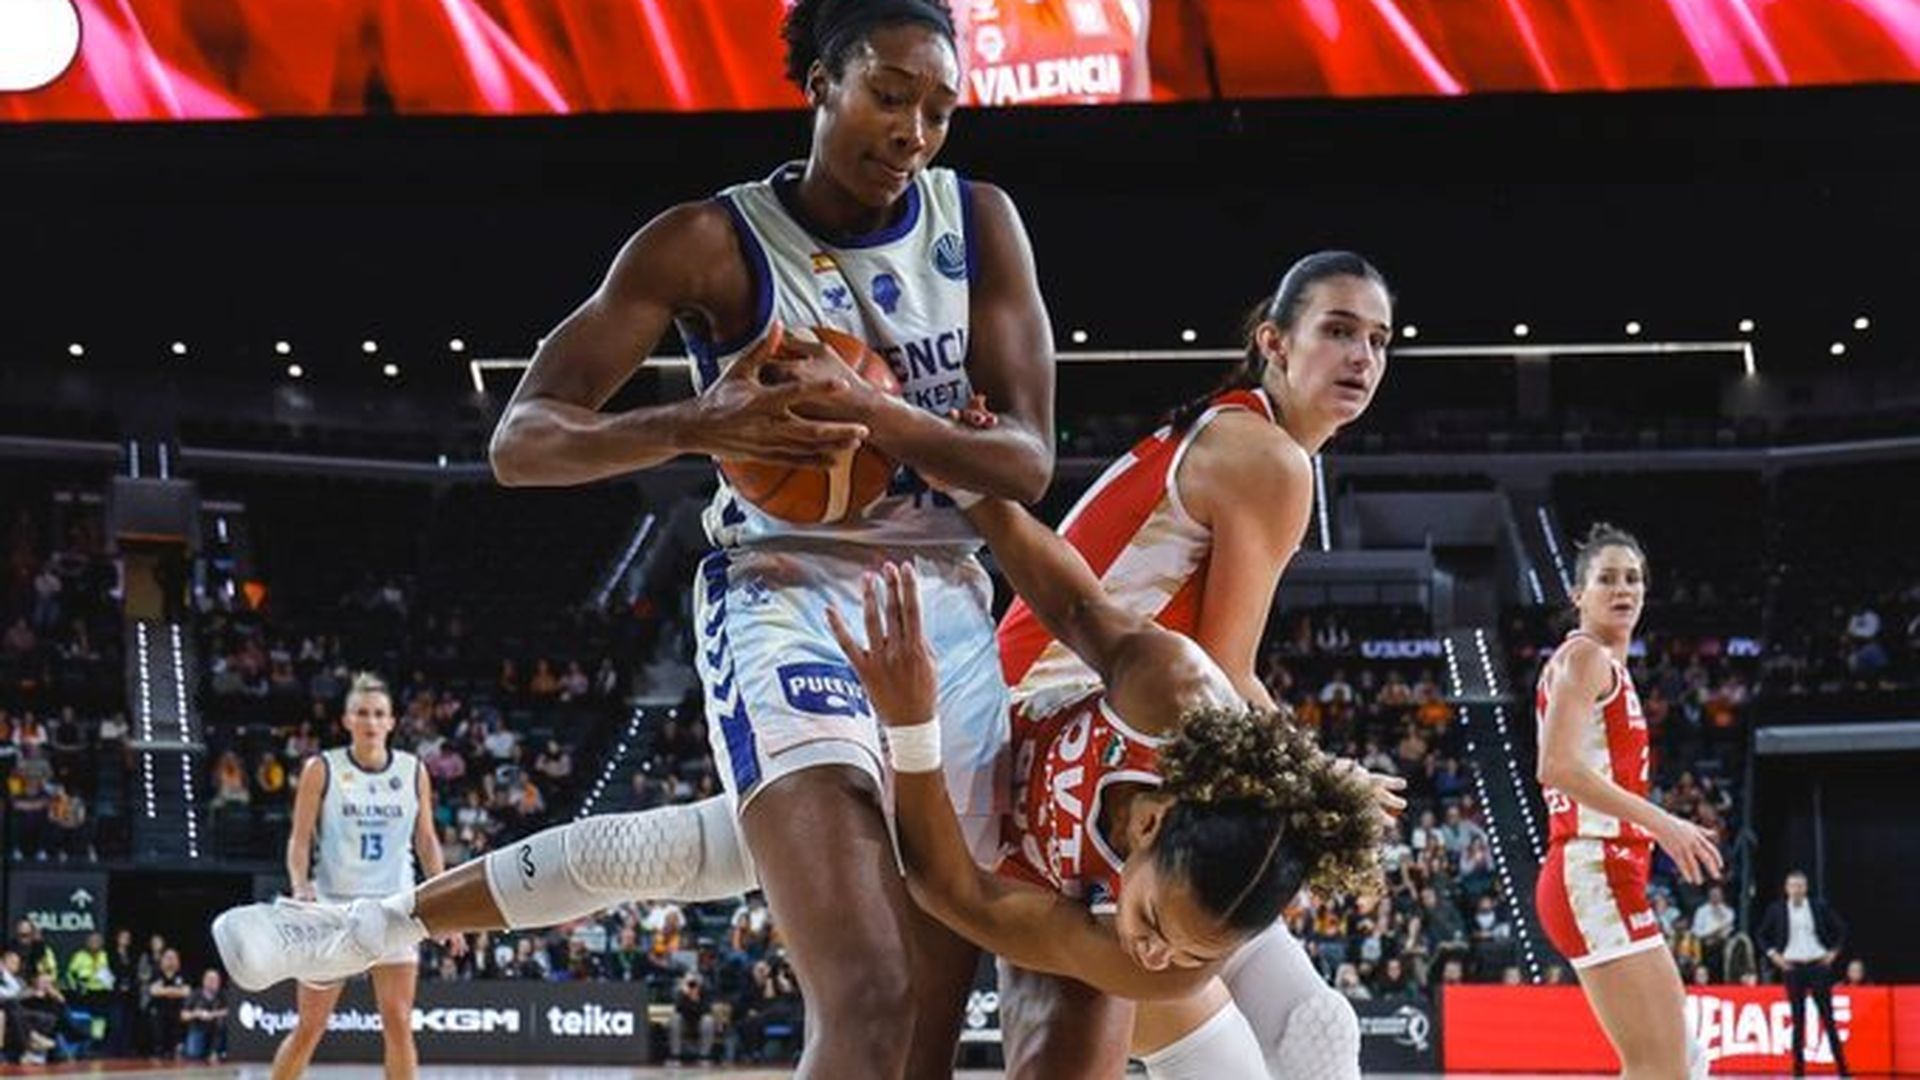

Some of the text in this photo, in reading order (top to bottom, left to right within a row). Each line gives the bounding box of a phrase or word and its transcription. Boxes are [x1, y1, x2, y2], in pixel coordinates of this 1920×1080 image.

[361, 832, 384, 860] 13
[27, 910, 95, 932] SALIDA
[410, 1008, 520, 1033] KGM
[546, 1003, 634, 1035] teika
